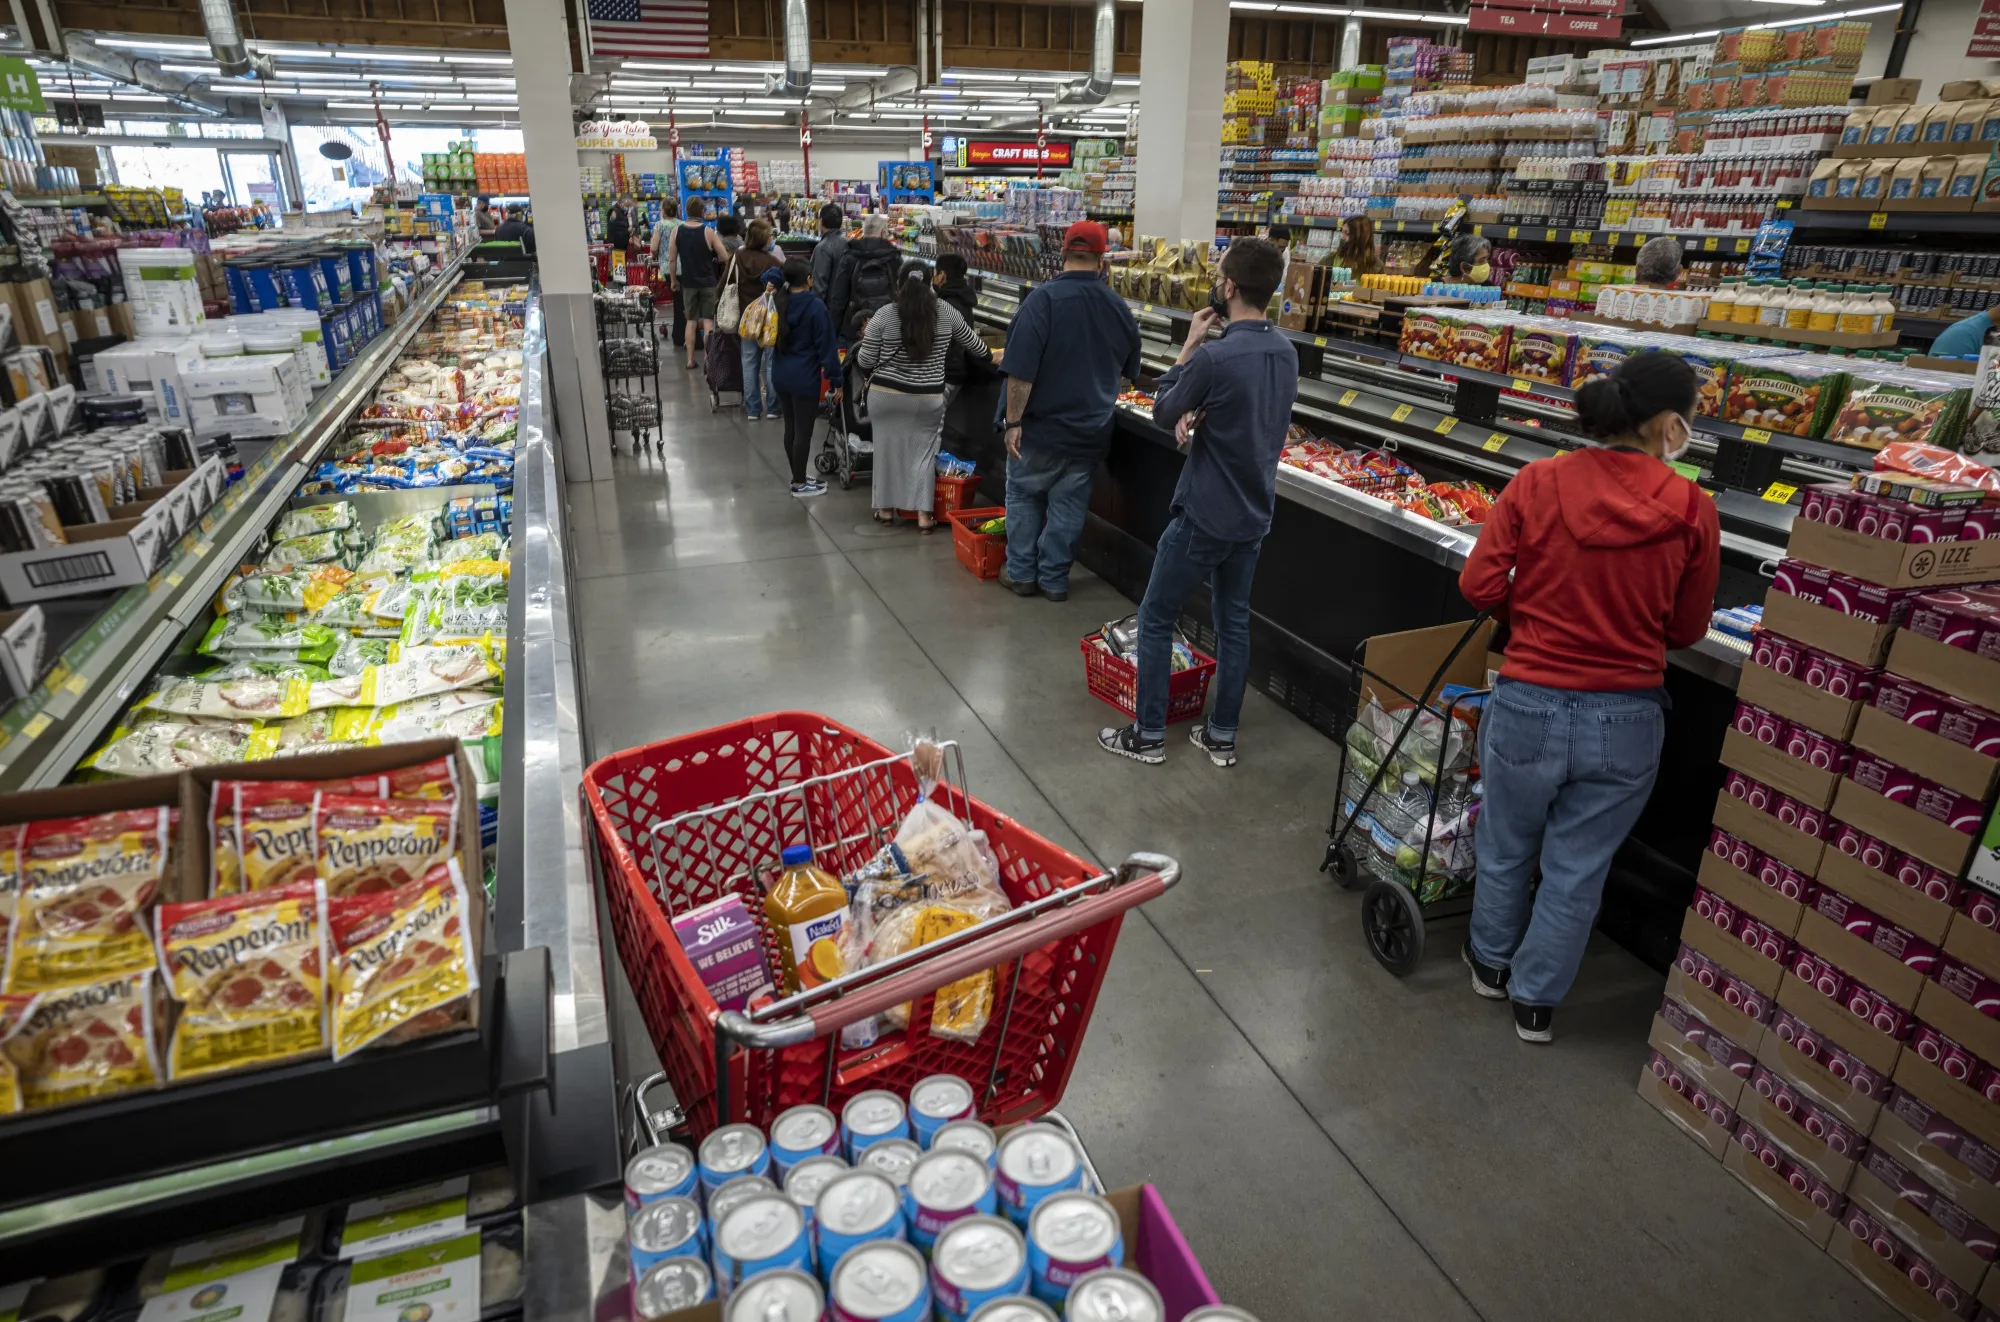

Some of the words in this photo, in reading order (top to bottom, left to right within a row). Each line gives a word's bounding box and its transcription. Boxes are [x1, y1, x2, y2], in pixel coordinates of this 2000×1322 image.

[1500, 16, 1515, 24] TEA
[1570, 20, 1598, 30] COFFEE
[6, 74, 29, 94] H
[379, 123, 386, 136] 1
[581, 122, 599, 134] See
[600, 122, 622, 137] You
[624, 122, 648, 136] Later
[670, 129, 679, 142] 3
[576, 138, 614, 148] SUPER
[618, 138, 656, 148] SAVER
[802, 130, 812, 144] 4
[924, 132, 932, 146] 5
[1038, 135, 1046, 148] 6
[993, 148, 1021, 159] CRAFT
[1022, 149, 1050, 160] BEES
[1583, 182, 1593, 191] ICE
[1575, 219, 1586, 228] ICE
[1422, 322, 1442, 332] DELIGHTS
[1470, 330, 1492, 342] DELIGHTS
[1608, 352, 1626, 364] DELIGH
[1694, 364, 1715, 378] ELIGHTS
[1940, 546, 1973, 564] IZZE
[1804, 568, 1830, 580] BLACKBERRY
[1860, 584, 1888, 597] BLACKBERRY
[326, 828, 444, 868] Pepperoni
[350, 894, 452, 972] Pepperoni
[697, 916, 737, 945] Silk
[178, 909, 312, 978] Pepperoni
[698, 954, 716, 970] WE
[714, 938, 756, 964] BELIEVE
[740, 977, 765, 993] PLANET
[19, 979, 134, 1036] epperoni
